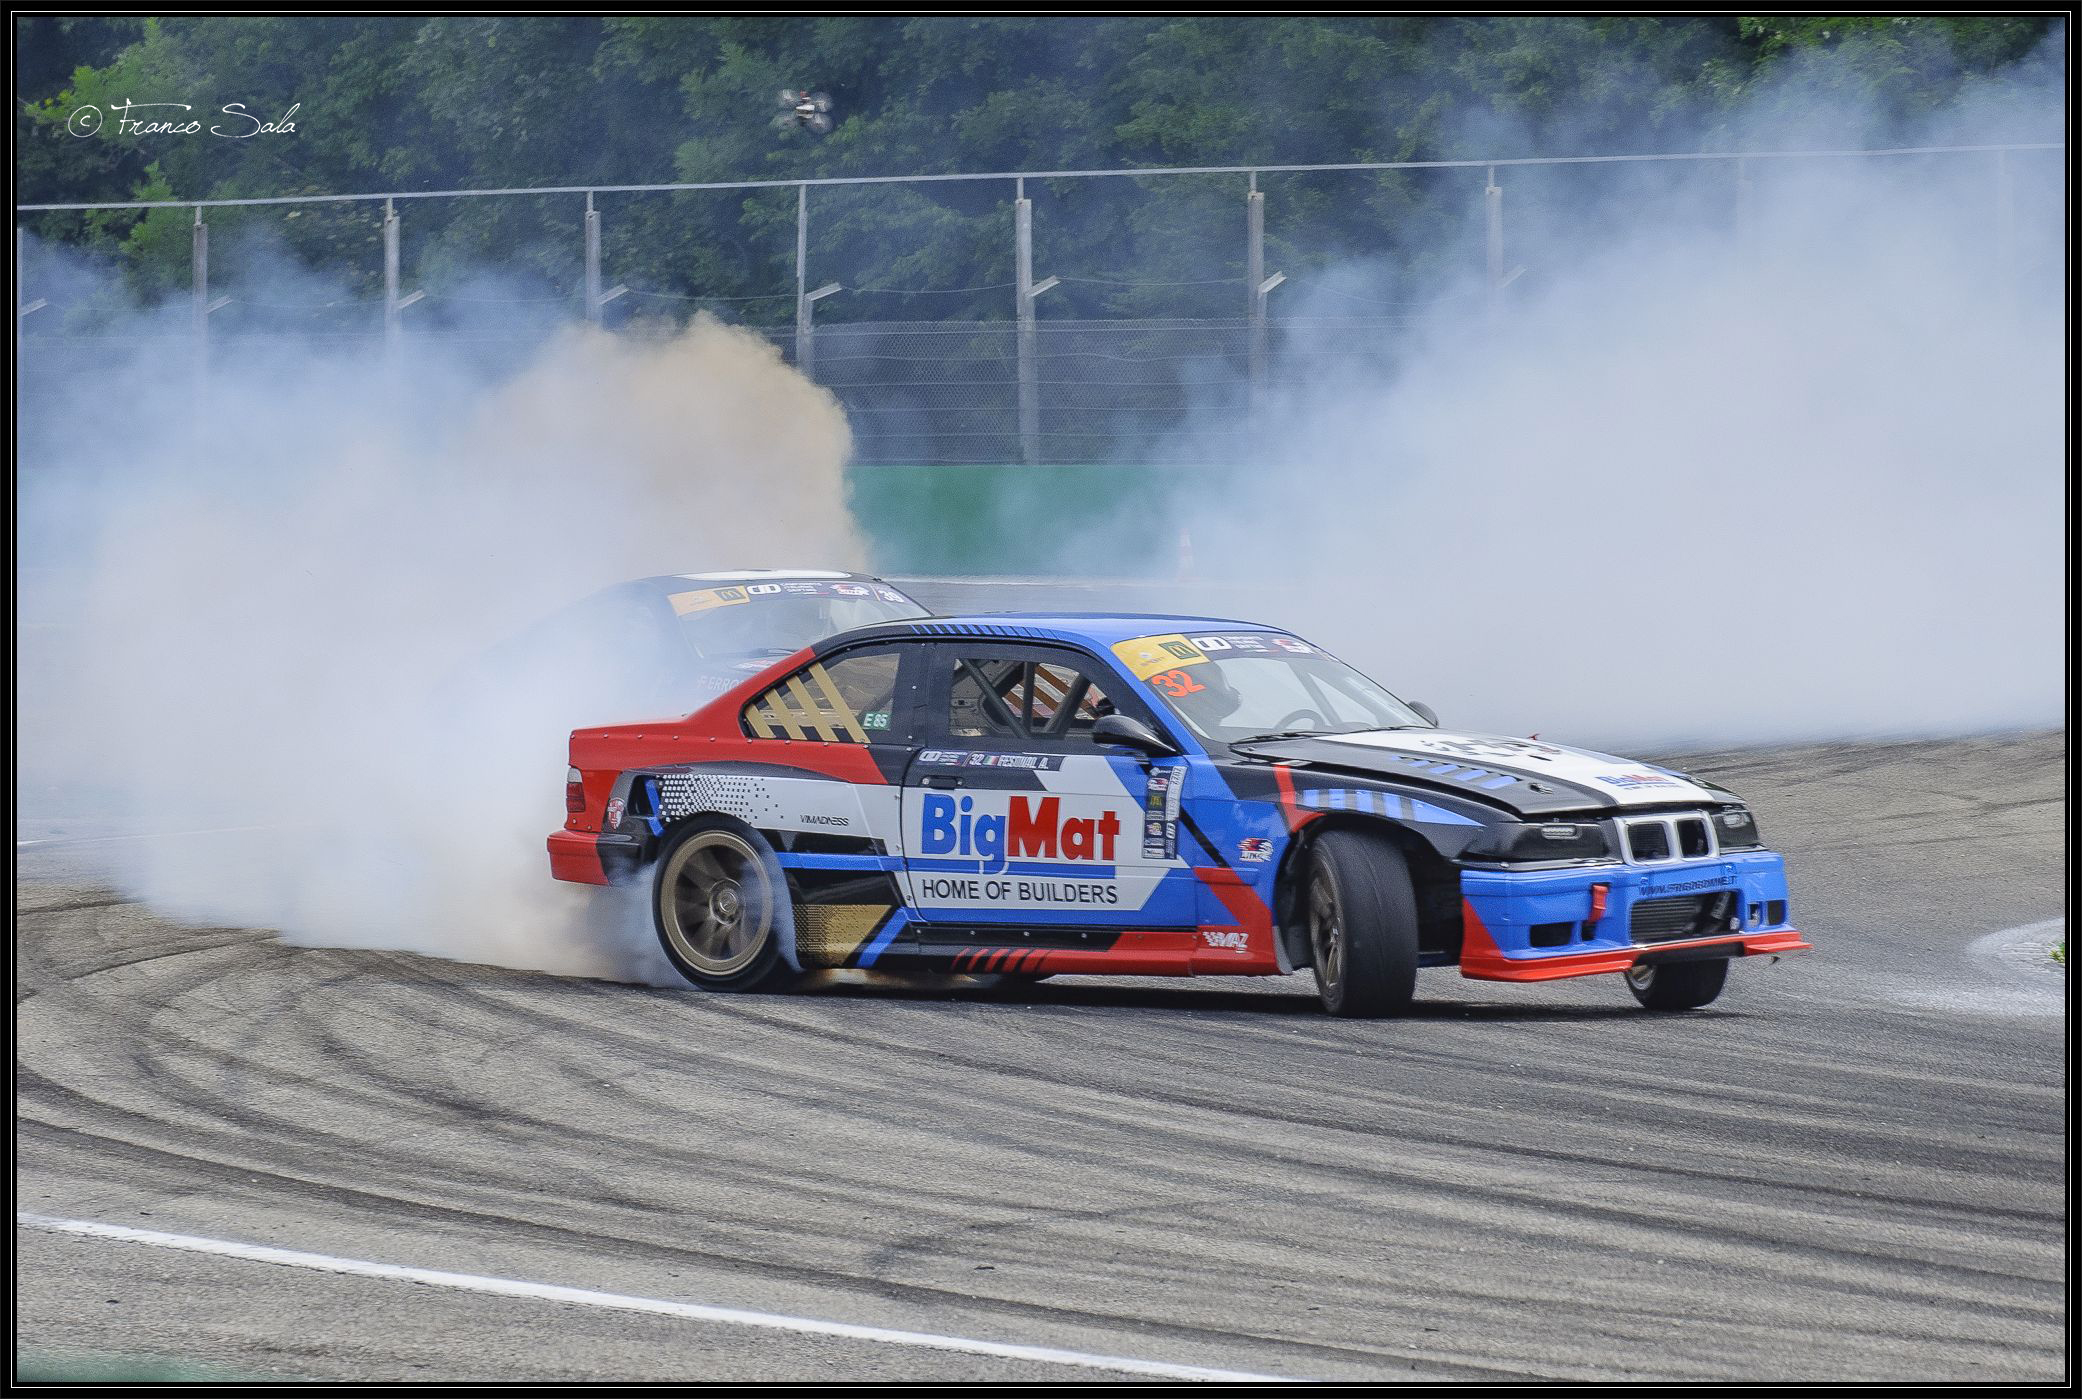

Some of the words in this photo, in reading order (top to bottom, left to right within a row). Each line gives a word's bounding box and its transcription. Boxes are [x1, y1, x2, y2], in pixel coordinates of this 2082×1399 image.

[1151, 669, 1206, 697] 32
[969, 753, 985, 766] 32
[922, 793, 1120, 875] BigMat
[922, 879, 979, 899] HOME
[985, 881, 1012, 900] OF
[1019, 882, 1118, 904] BUILDERS
